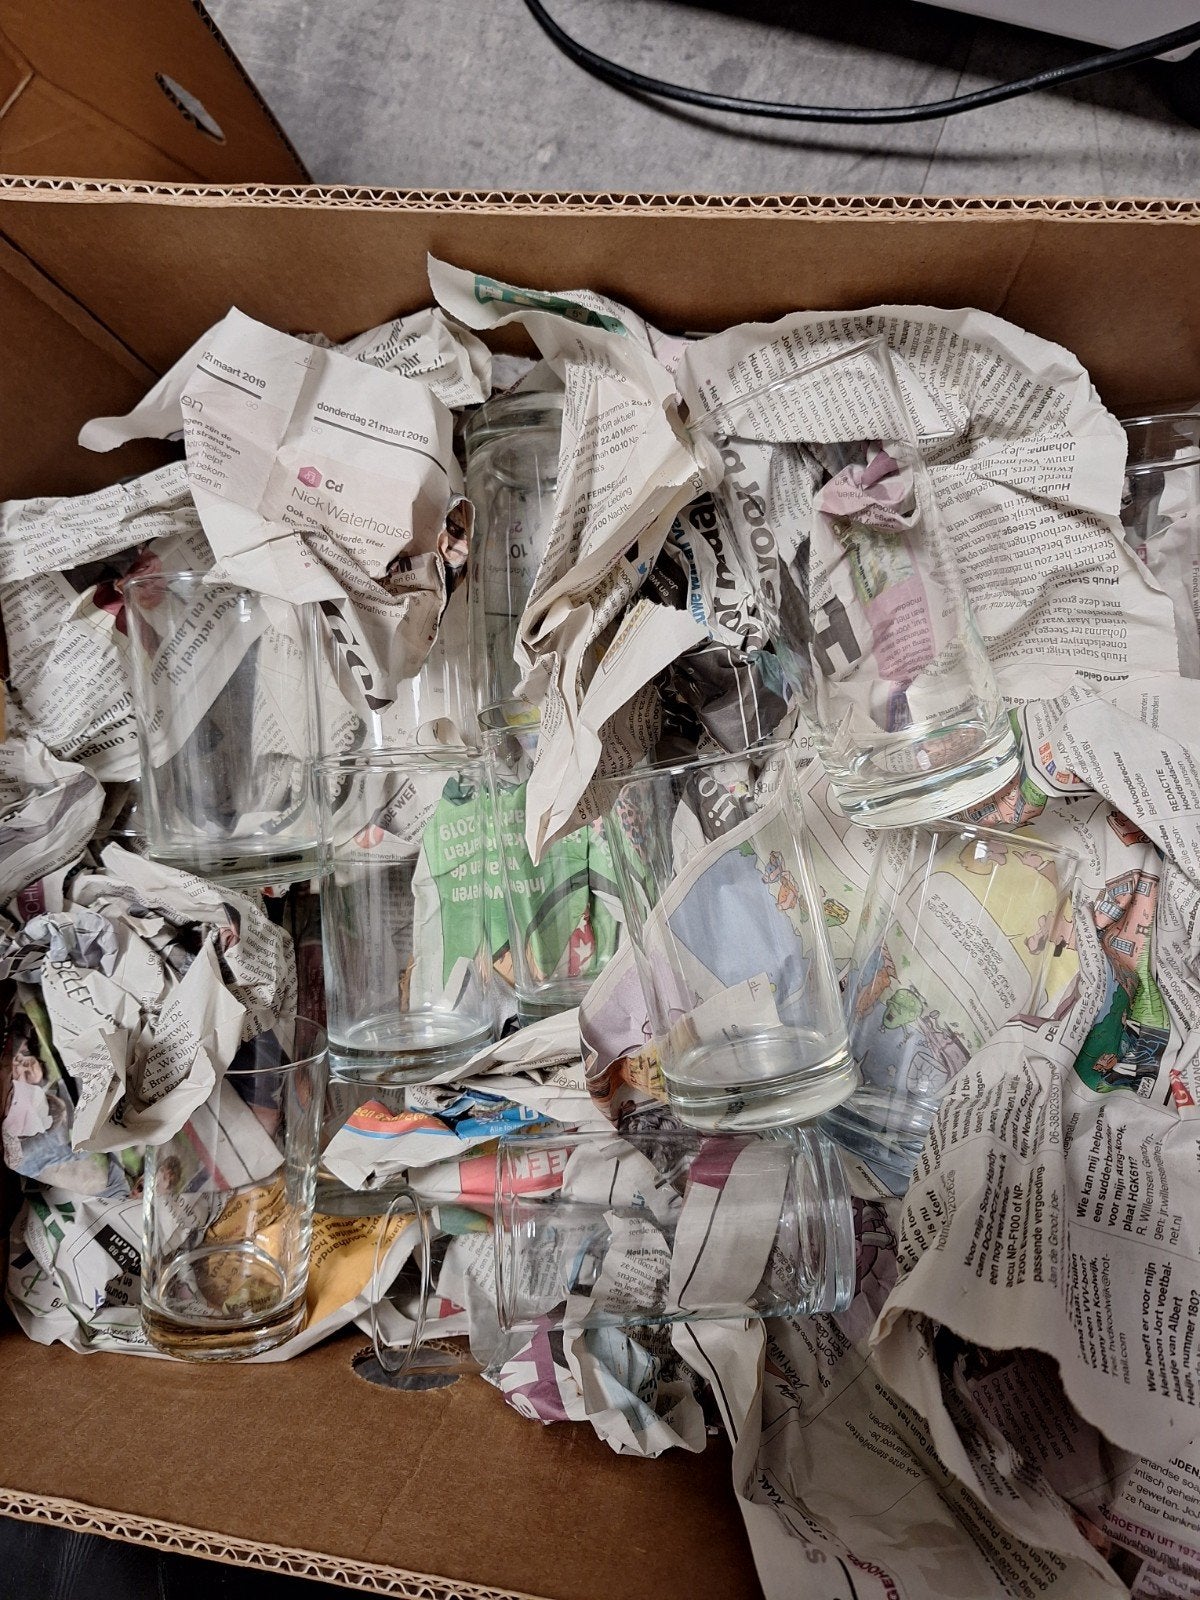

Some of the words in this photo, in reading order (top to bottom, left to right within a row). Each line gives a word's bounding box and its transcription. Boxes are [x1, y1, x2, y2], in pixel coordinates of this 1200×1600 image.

[213, 358, 241, 378] maart
[242, 372, 266, 389] 2019
[748, 352, 762, 381] Huub:
[807, 399, 824, 427] mooie
[843, 398, 859, 424] alleen
[1030, 385, 1055, 420] Johanna:
[317, 402, 367, 428] donderdag
[368, 418, 378, 429] 21
[380, 424, 406, 438] maart
[406, 431, 430, 445] 2019
[196, 430, 224, 446] strand
[226, 444, 241, 455] van
[1027, 441, 1076, 459] Johanna:
[325, 478, 344, 494] Cd
[1038, 482, 1070, 496] Huub:
[286, 504, 304, 519] Ook
[292, 486, 324, 511] Nick
[327, 502, 412, 540] Waterhouse
[1039, 515, 1055, 525] ter
[1034, 555, 1053, 566] zou
[1054, 549, 1072, 560] het
[1073, 557, 1096, 571] met
[1096, 549, 1116, 563] pen
[1105, 564, 1119, 574] de
[341, 570, 390, 598] Waterhouse
[1078, 597, 1100, 608] deze
[1059, 633, 1126, 652] toneelschrijver
[1084, 625, 1127, 640] (Johanna
[1072, 645, 1099, 658] Stapel
[1100, 651, 1127, 662] Huub
[1114, 750, 1144, 818] Verkoopdirecteur
[1156, 768, 1178, 812] REDACTIE
[1162, 750, 1192, 810] Hoofdredacteur
[1144, 796, 1157, 816] Bert
[169, 1010, 185, 1022] De
[165, 1042, 178, 1052] ze
[178, 1030, 194, 1045] ook
[148, 1070, 173, 1088] Broer
[1089, 1119, 1103, 1153] helpen
[1019, 1137, 1029, 1158] Mijn
[1087, 1155, 1099, 1172] mij
[1034, 1163, 1046, 1223] vergoeding.
[1080, 1174, 1093, 1195] kan
[964, 1240, 976, 1266] Voor
[973, 1214, 984, 1238] mijn
[979, 1185, 992, 1212] Sony
[986, 1148, 996, 1183] Handy-
[1076, 1197, 1089, 1217] Wie
[1093, 1202, 1103, 1222] een
[1107, 1202, 1119, 1226] voor
[1114, 1178, 1125, 1200] mijn
[1123, 1203, 1135, 1231] plaat
[1007, 1206, 1020, 1257] NP-F100
[1135, 1225, 1147, 1235] R.
[992, 1240, 1003, 1262] nog
[1033, 1226, 1045, 1283] passende
[1005, 1261, 1015, 1287] accu
[1144, 1262, 1156, 1286] mijn
[1157, 1262, 1171, 1306] voetbal-
[1153, 1309, 1163, 1335] Jort
[1168, 1296, 1182, 1332] Albert
[1141, 1333, 1152, 1366] heeft
[1182, 1319, 1194, 1368] nummer
[874, 1383, 897, 1409] eerste
[897, 1408, 910, 1426] het
[953, 1488, 1000, 1538] Provinciale
[1138, 1498, 1160, 1514] haar
[999, 1536, 1011, 1550] de
[1156, 1535, 1174, 1547] UIT
[1011, 1551, 1029, 1572] voor
[1028, 1548, 1057, 1583] Staten
